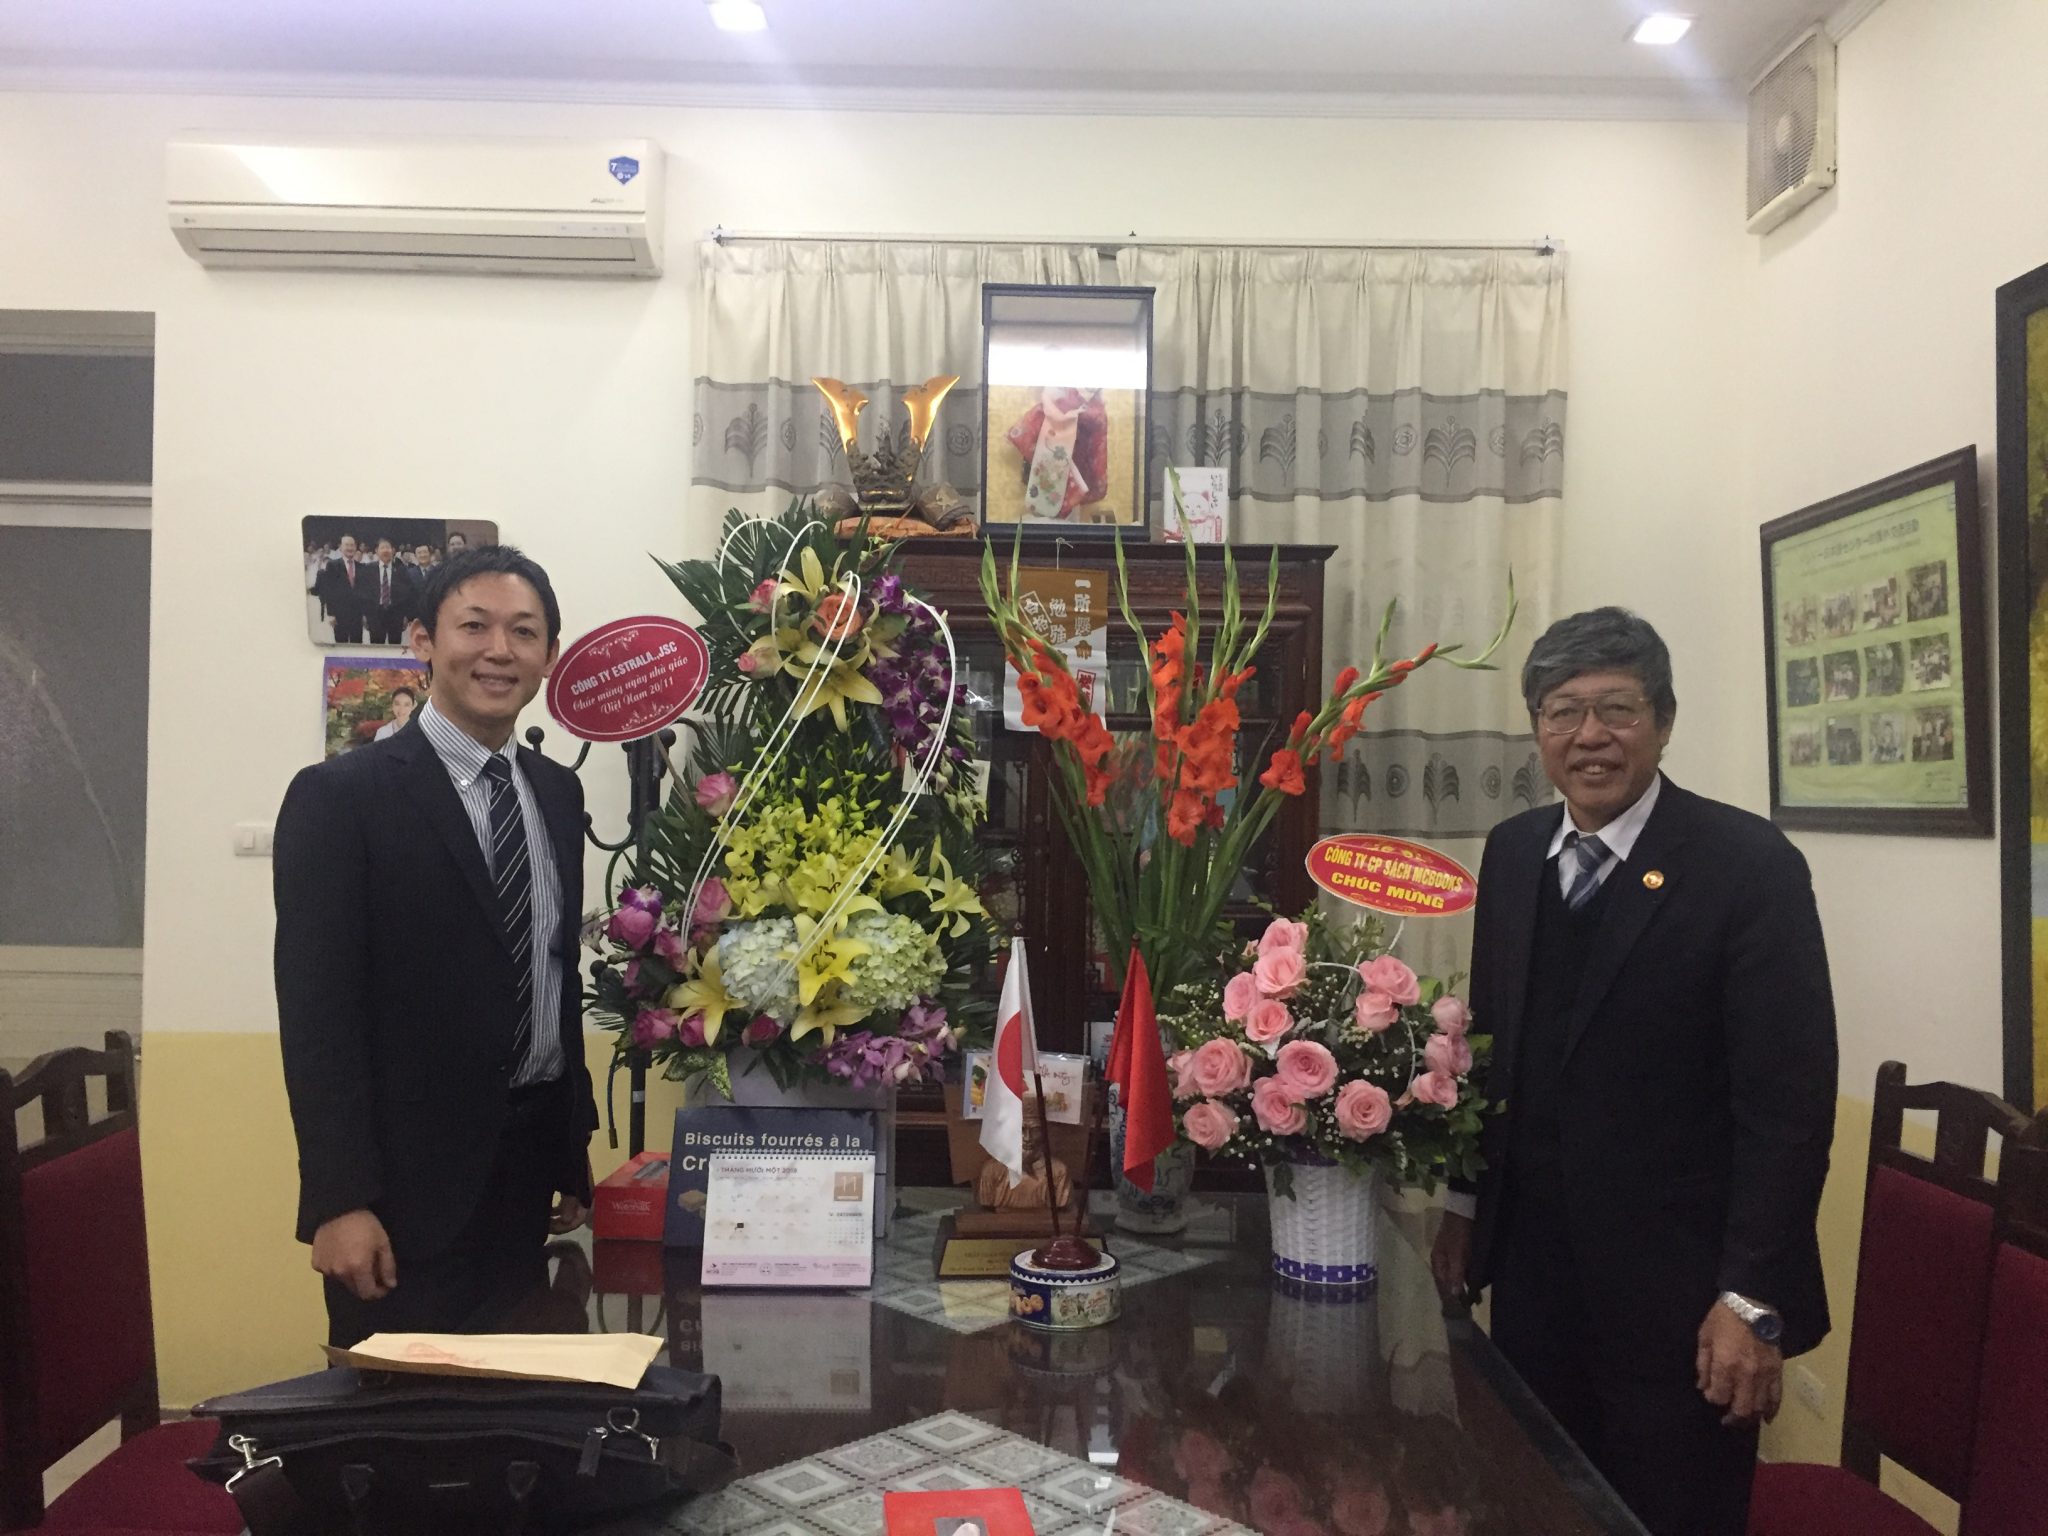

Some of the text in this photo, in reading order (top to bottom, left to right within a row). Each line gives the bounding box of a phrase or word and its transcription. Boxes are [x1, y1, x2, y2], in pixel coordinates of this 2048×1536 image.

[1024, 598, 1049, 632] 合格
[1049, 598, 1068, 658] 勉強
[571, 675, 599, 696] CÔNG
[598, 669, 611, 684] TY
[573, 696, 596, 712] Chúc
[625, 674, 648, 691] ngày
[649, 663, 666, 679] nhà
[668, 655, 688, 672] giáo
[601, 676, 674, 715] Việt Nam 20/11
[1324, 845, 1464, 892] CÔNG TY CP SÁCH MCBOOKS
[1331, 872, 1445, 909] CHÚC MỪNG
[685, 1132, 860, 1147] Biscuits fourrés à la
[682, 1155, 710, 1171] Cr
[840, 1175, 857, 1193] 11
